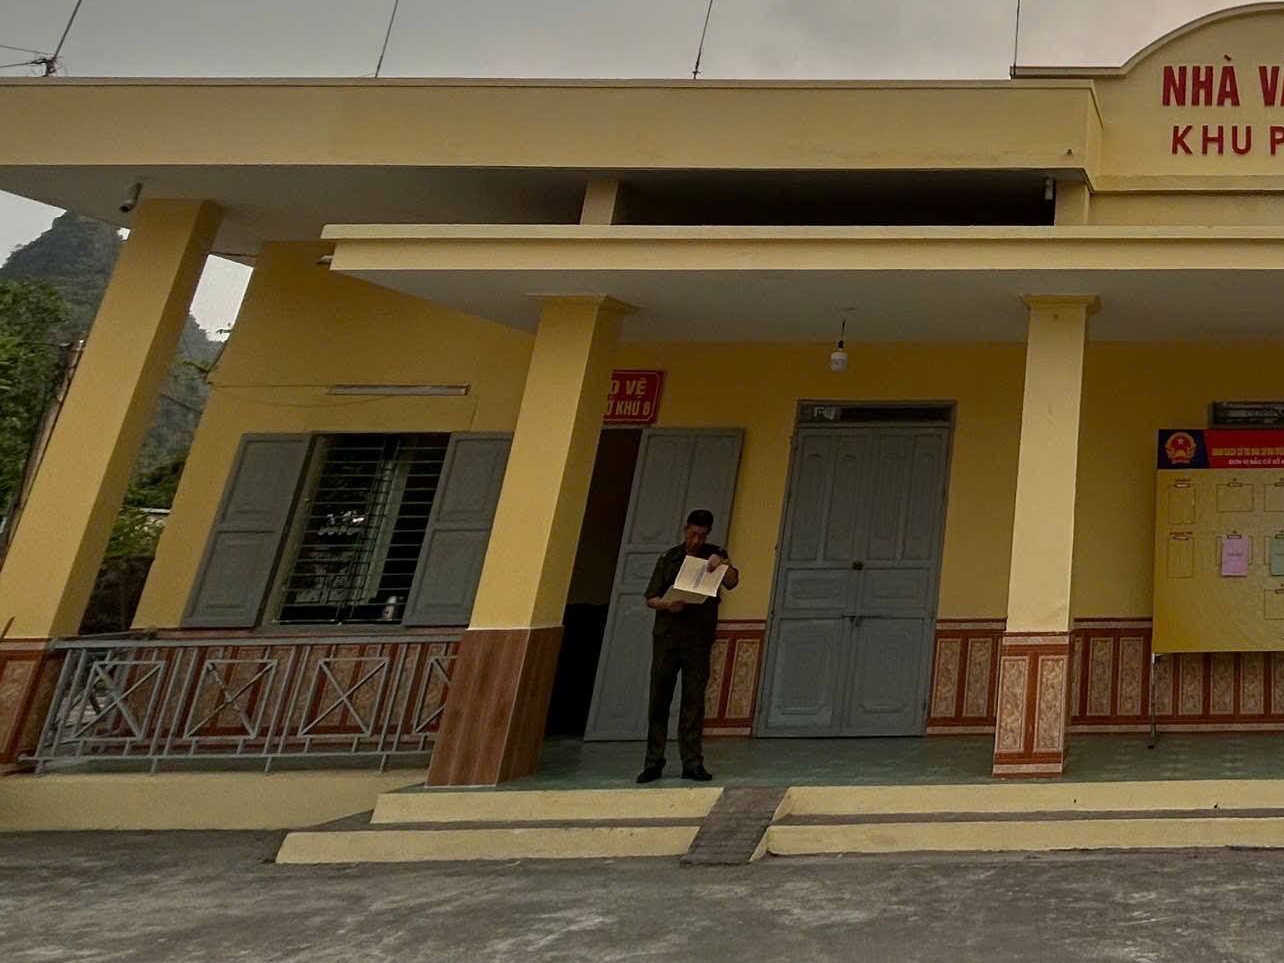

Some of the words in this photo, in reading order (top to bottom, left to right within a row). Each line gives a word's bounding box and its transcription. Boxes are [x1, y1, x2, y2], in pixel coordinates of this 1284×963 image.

[1162, 55, 1240, 107] NHÀ
[1171, 125, 1252, 155] KHU
[626, 377, 647, 398] VỆ
[615, 400, 641, 416] KHU
